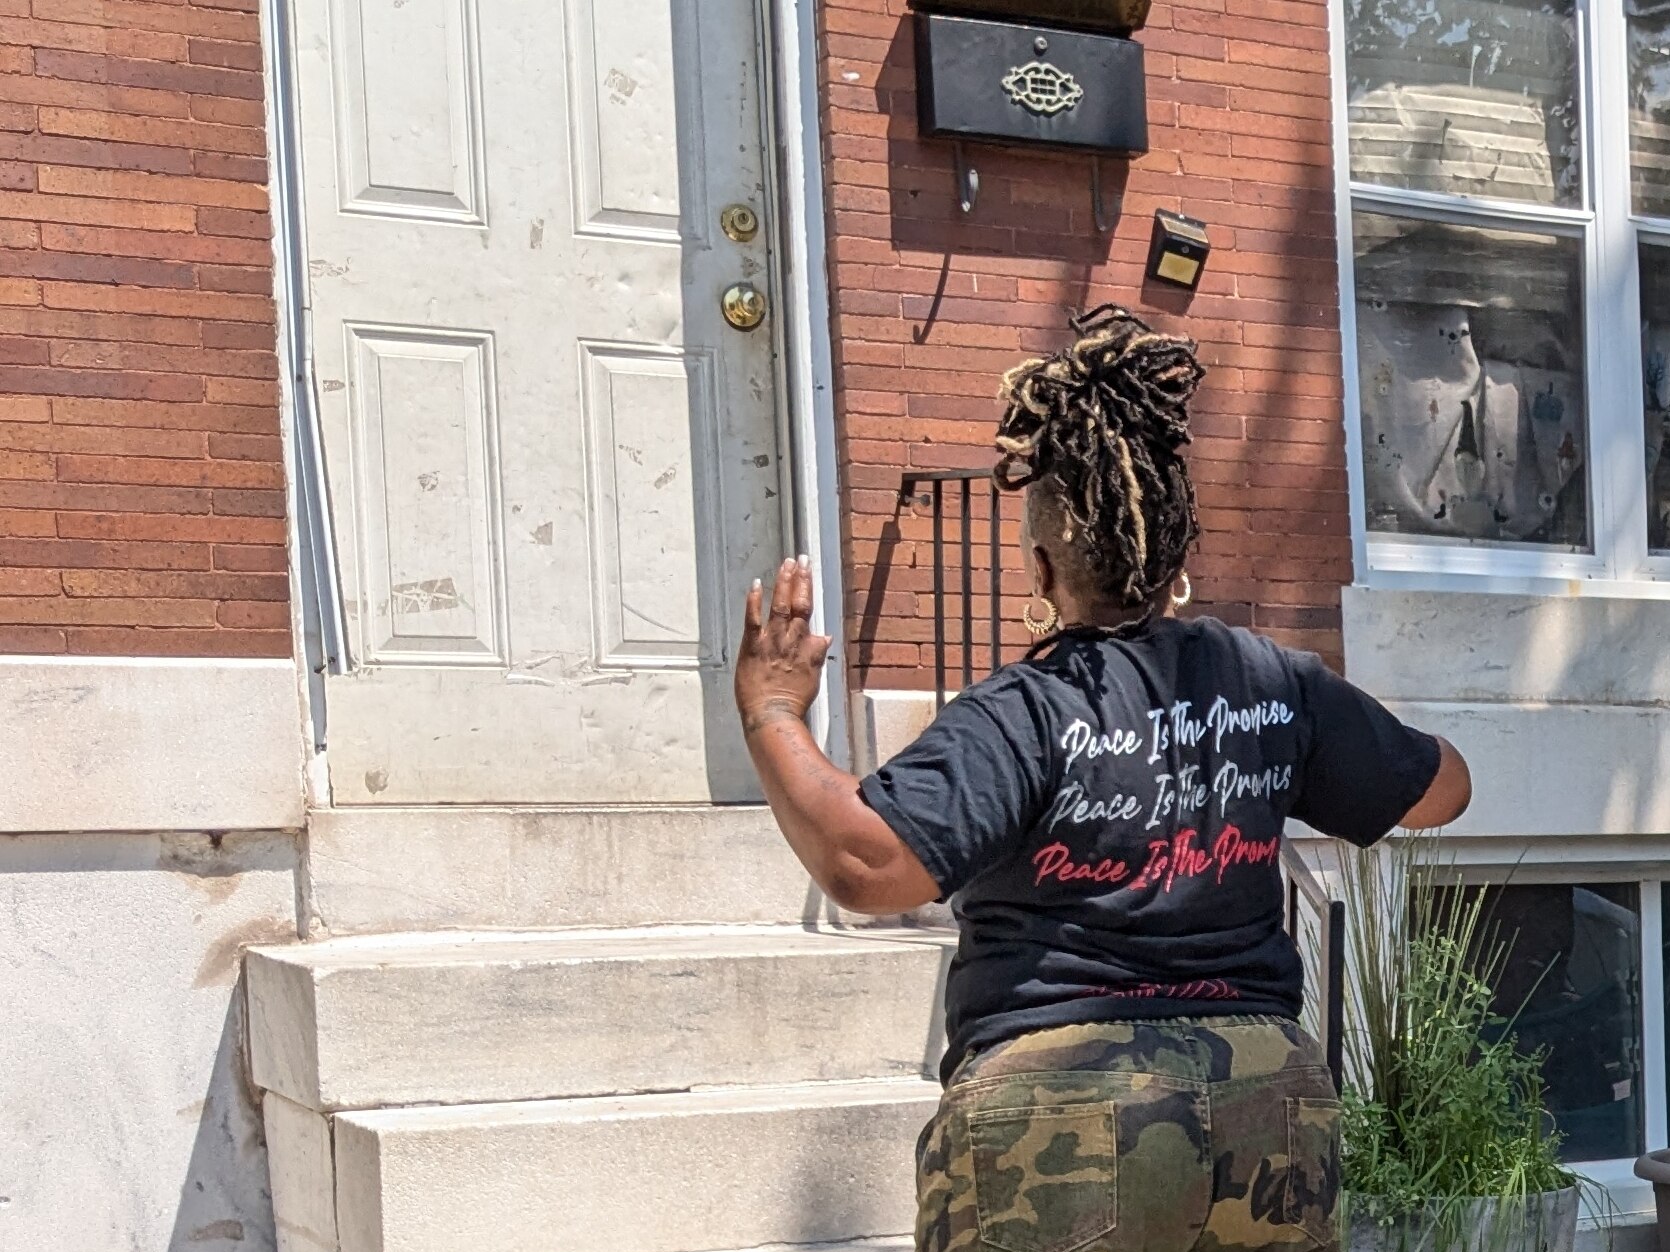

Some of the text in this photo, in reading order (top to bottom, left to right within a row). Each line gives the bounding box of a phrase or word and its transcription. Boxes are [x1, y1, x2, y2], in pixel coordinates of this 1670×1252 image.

[1061, 695, 1294, 775] Peace Is The Promise
[1048, 760, 1291, 834] Peace Is The Promis
[1032, 824, 1276, 893] Peace Is The Prom
